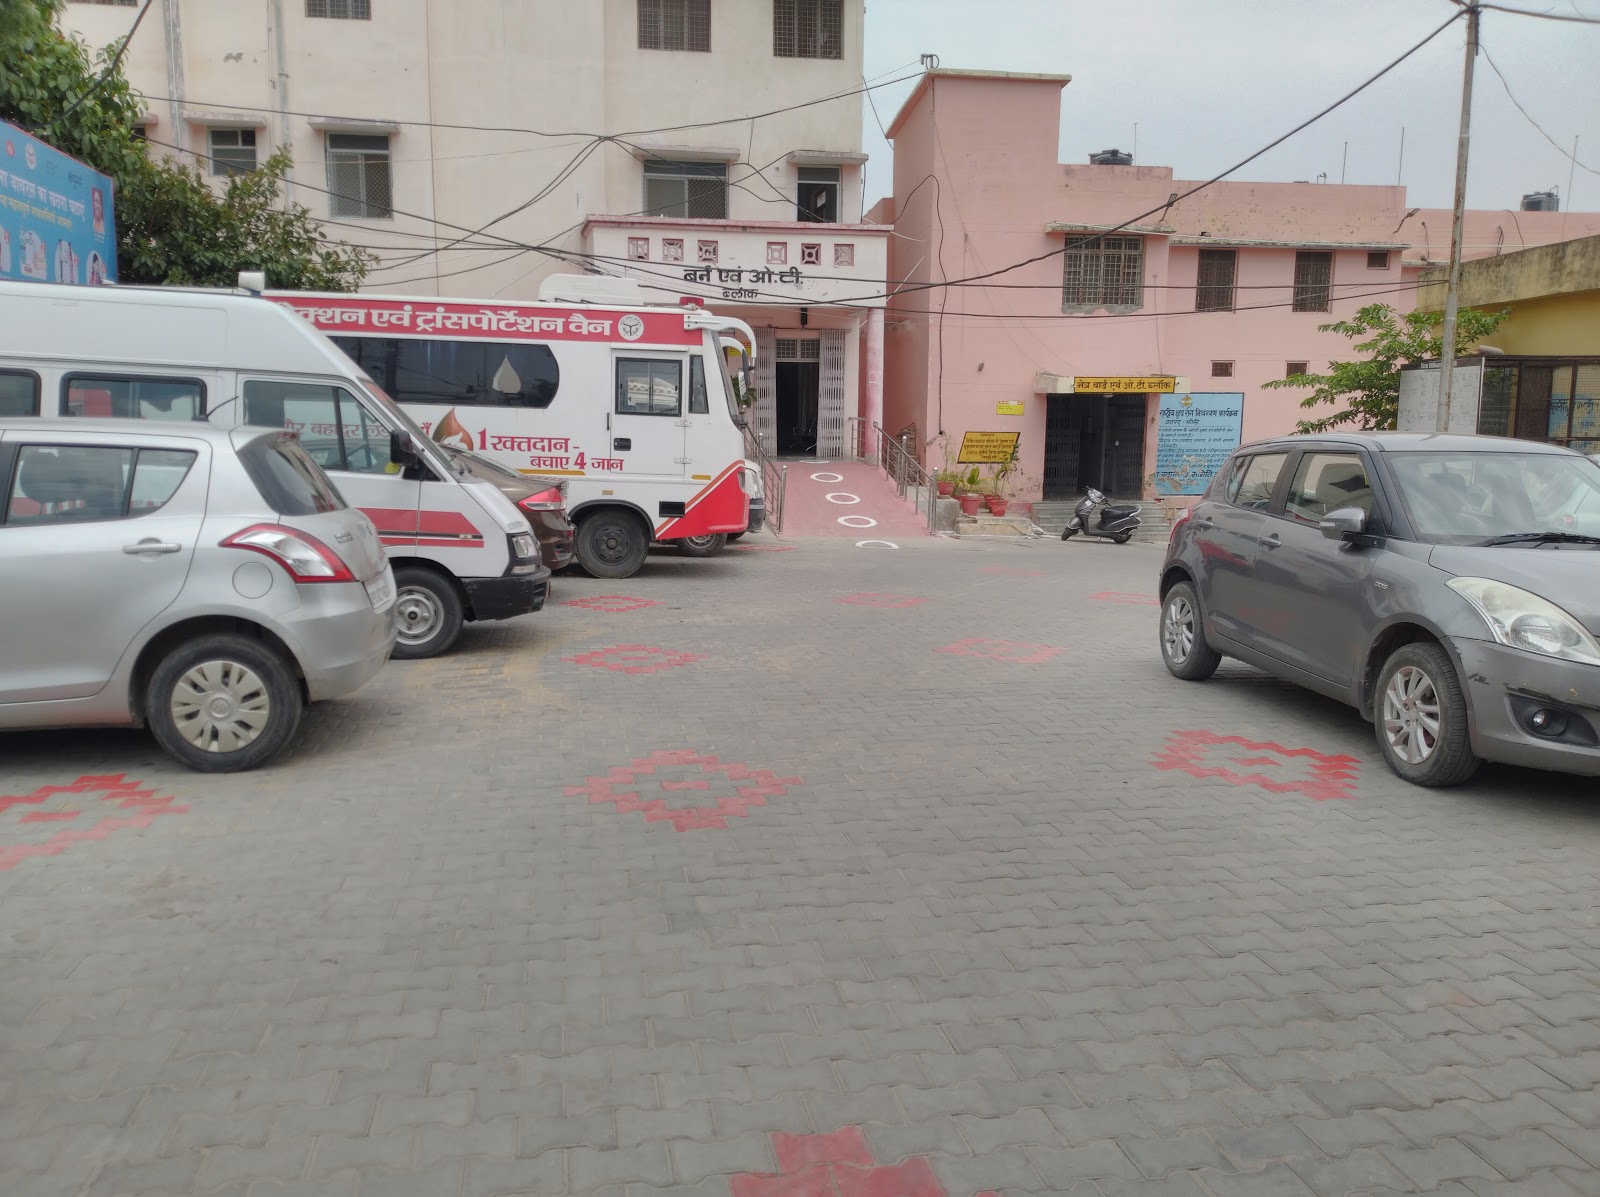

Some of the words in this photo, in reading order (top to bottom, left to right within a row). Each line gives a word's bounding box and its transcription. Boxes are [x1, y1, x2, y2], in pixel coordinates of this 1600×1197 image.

[718, 265, 743, 283] एवं
[370, 304, 413, 327] एवं
[415, 305, 565, 334] ट्रांसपोर्टेशन
[568, 313, 613, 336] वैन
[478, 428, 488, 450] 1
[490, 435, 571, 453] रक्तदान
[529, 455, 570, 470] बचाए
[574, 452, 587, 470] 4
[591, 457, 625, 472] जान
